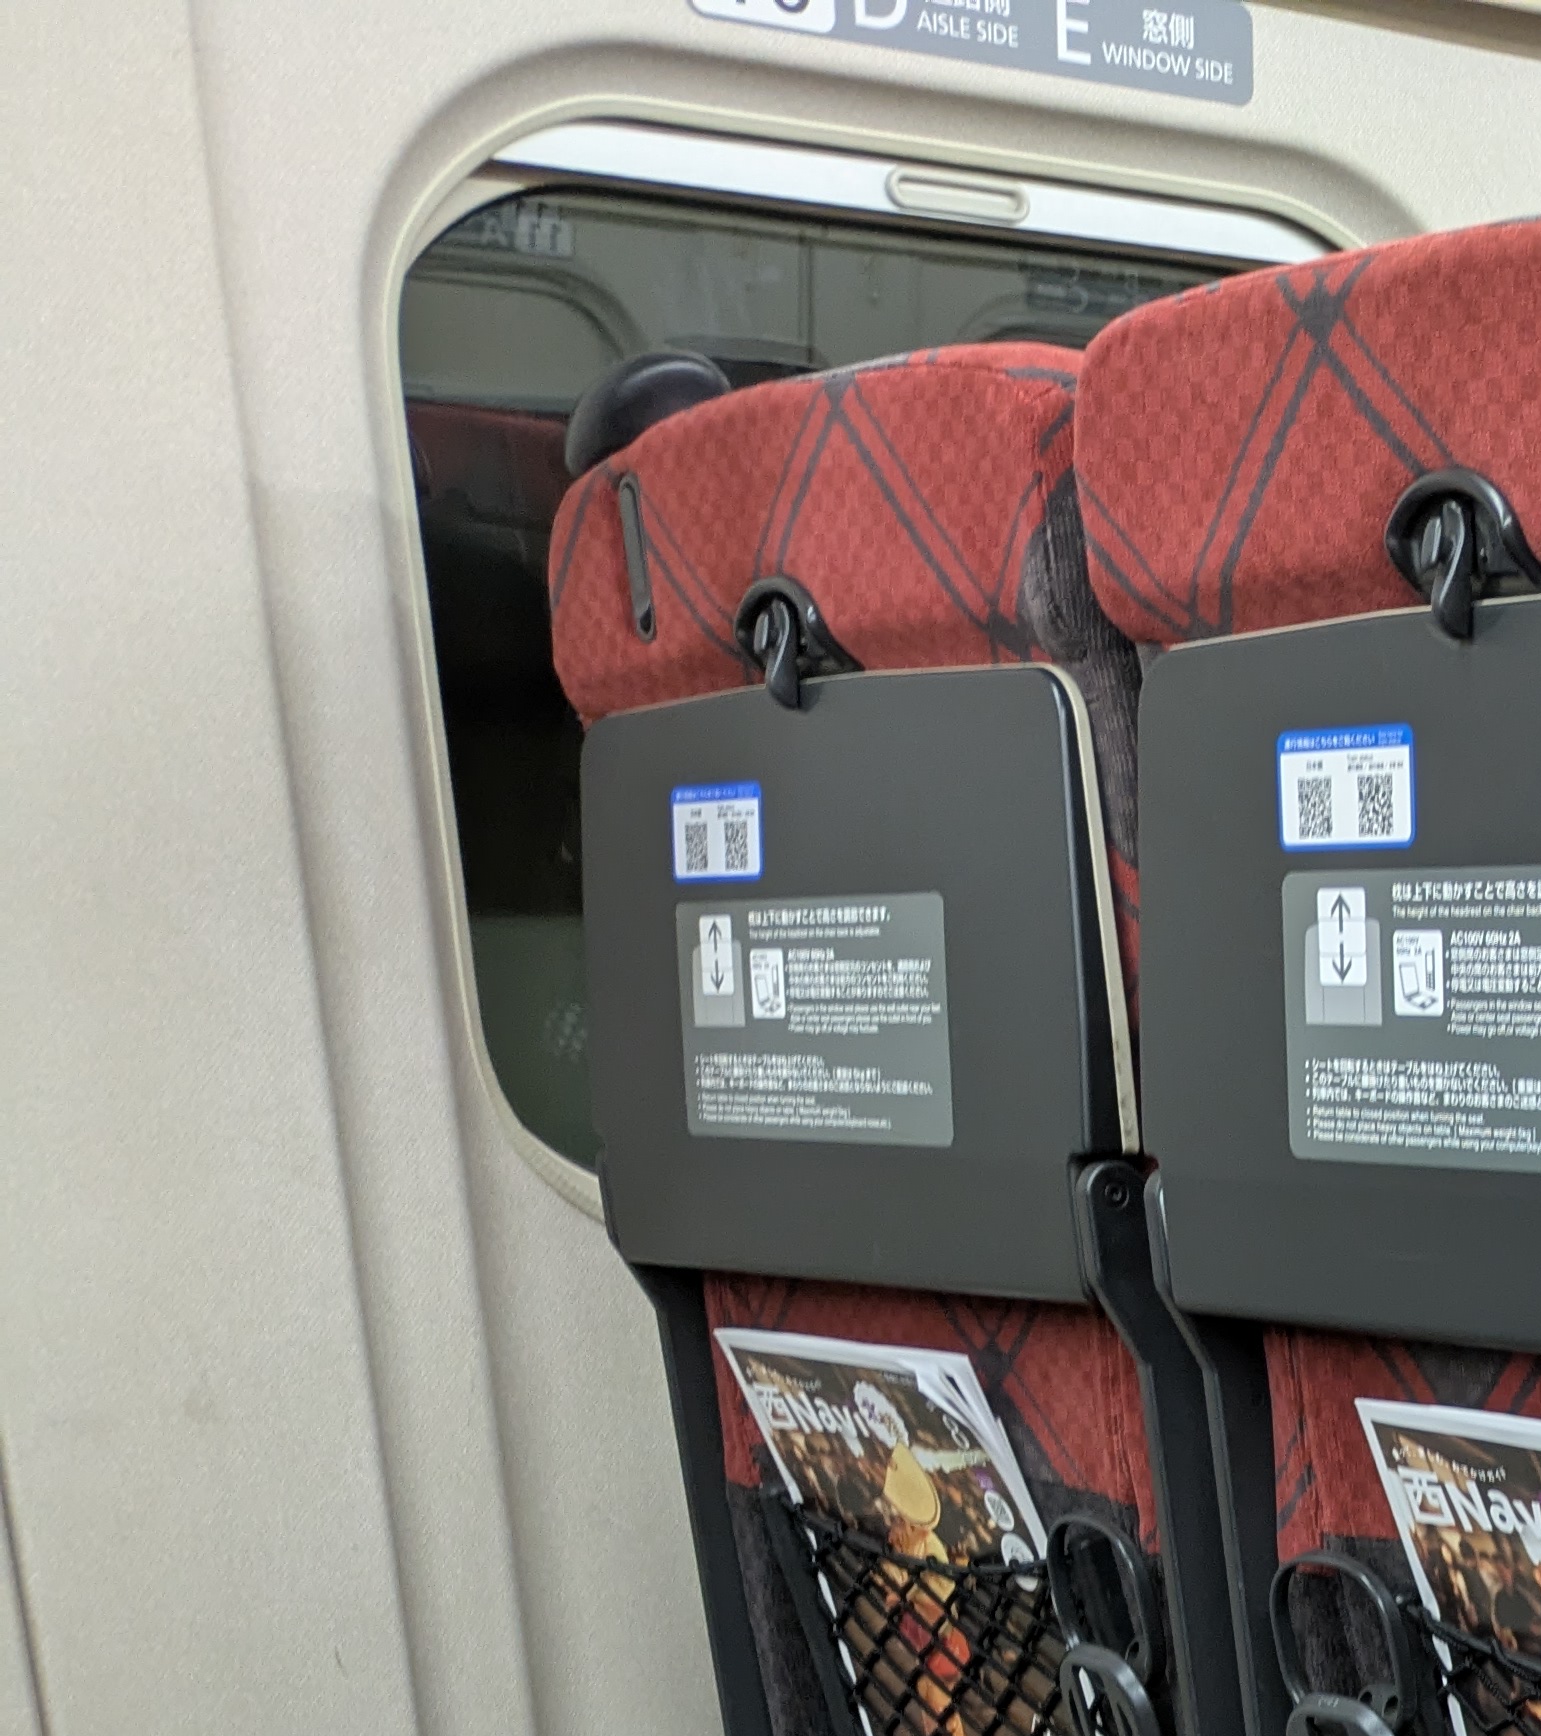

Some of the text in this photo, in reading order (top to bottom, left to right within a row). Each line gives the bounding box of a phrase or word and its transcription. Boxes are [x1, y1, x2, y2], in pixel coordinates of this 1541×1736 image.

[917, 10, 971, 40] AISLE
[976, 20, 1019, 48] SIDE
[1056, 0, 1092, 66] E
[1142, 8, 1195, 50] 窓側
[1101, 41, 1234, 86] WINDOW SIDE
